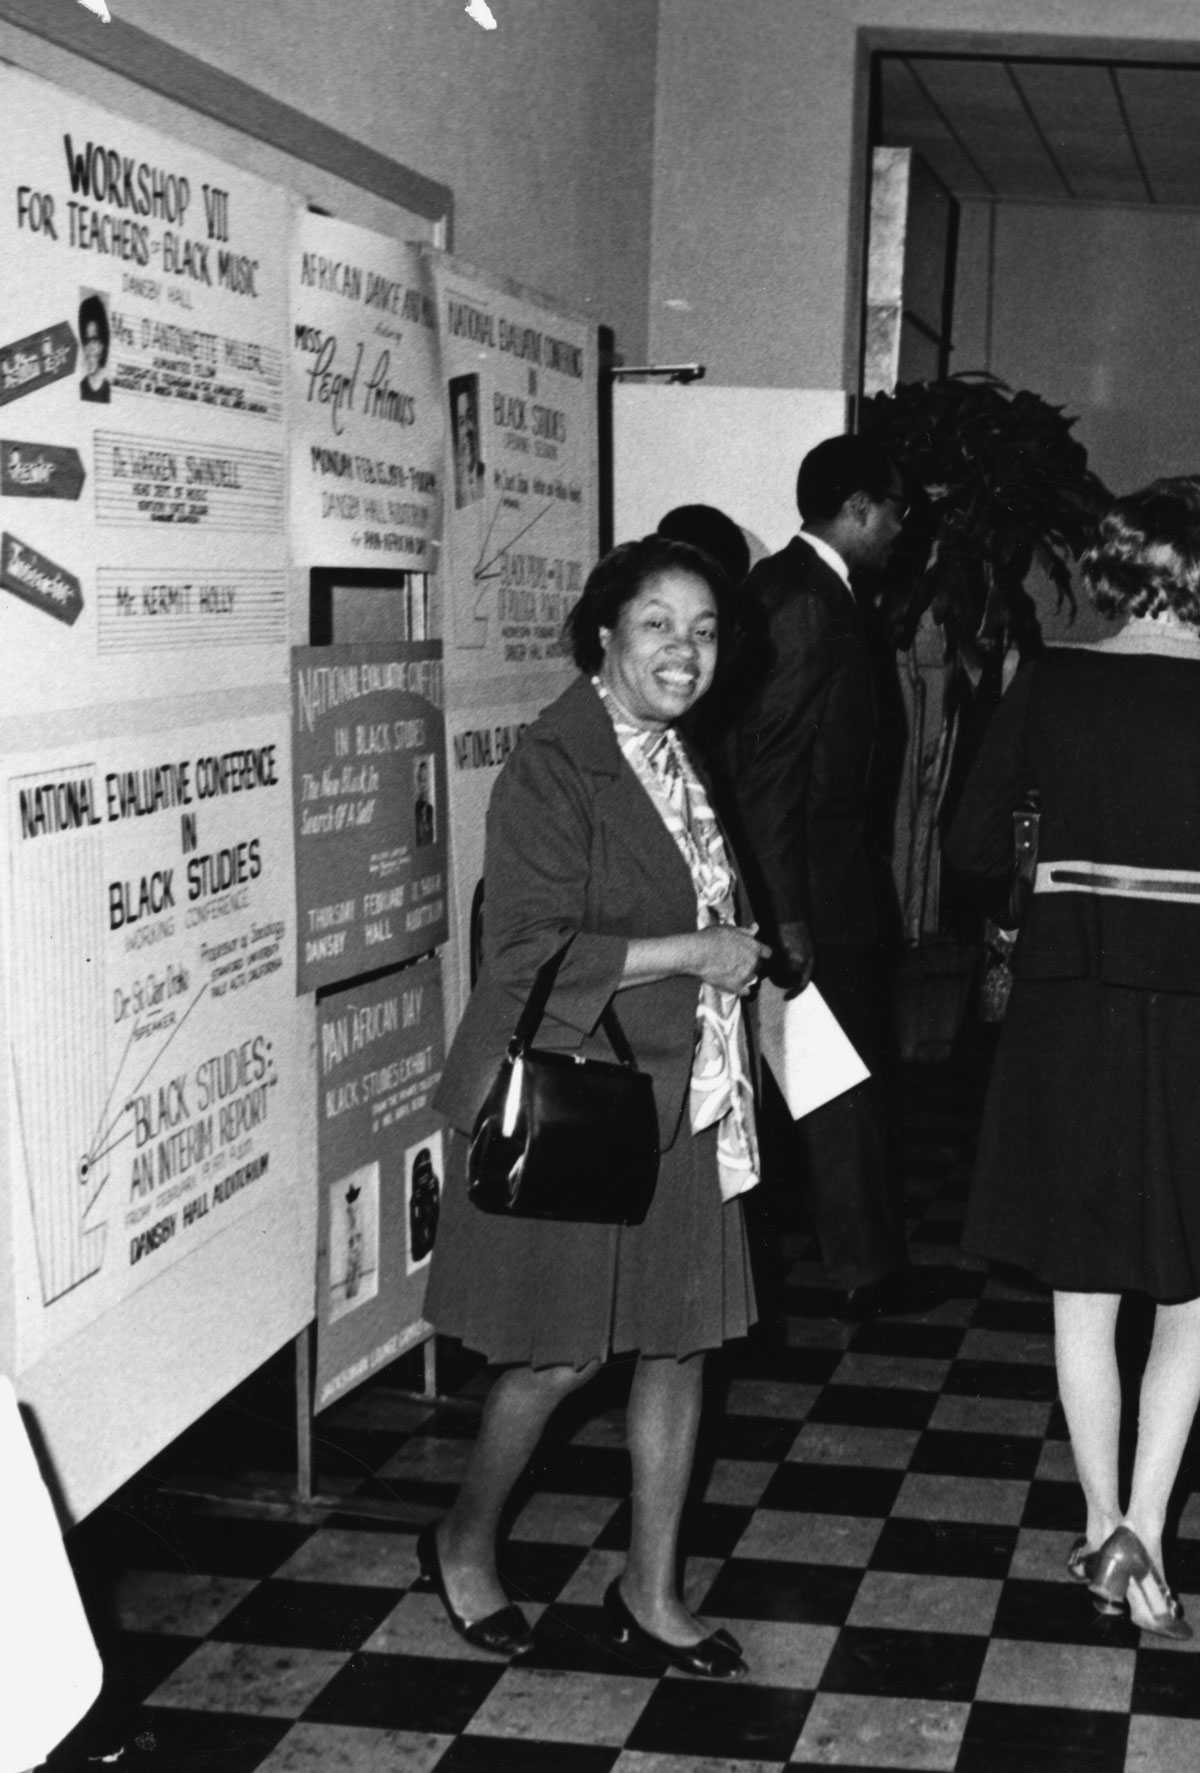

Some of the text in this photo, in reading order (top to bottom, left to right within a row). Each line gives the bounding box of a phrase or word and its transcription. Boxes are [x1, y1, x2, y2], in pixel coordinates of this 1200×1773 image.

[63, 133, 191, 227] WORKSHOP
[17, 186, 58, 240] FOR
[66, 201, 149, 267] TEACHERS
[163, 231, 213, 287] BLACK
[218, 250, 259, 298] MUSIC
[20, 778, 101, 840] NATIONAL
[105, 761, 192, 822] EVALUATIVE
[196, 744, 278, 800] CONFERENCE
[109, 838, 261, 931] BLACK STUDIES
[130, 1149, 153, 1203] AN
